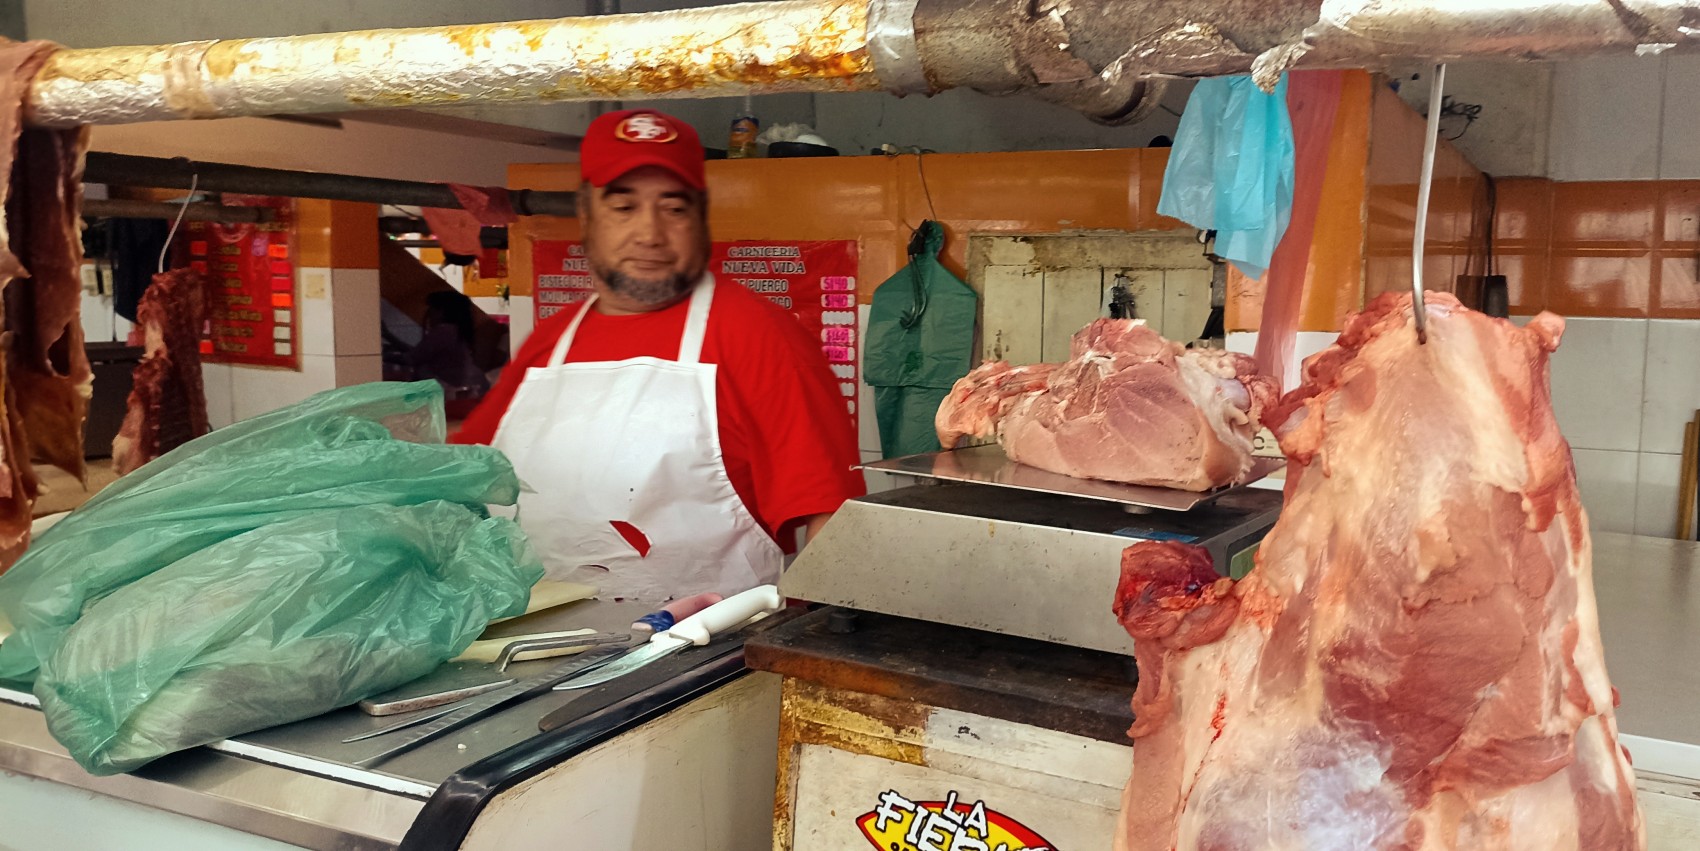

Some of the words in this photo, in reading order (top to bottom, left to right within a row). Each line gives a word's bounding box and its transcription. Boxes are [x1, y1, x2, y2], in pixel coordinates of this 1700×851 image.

[728, 246, 800, 257] CARNICERIA
[723, 261, 769, 274] NUEVA
[772, 261, 806, 274] VIDA
[748, 279, 788, 292] PUERCO
[942, 790, 988, 838] LA
